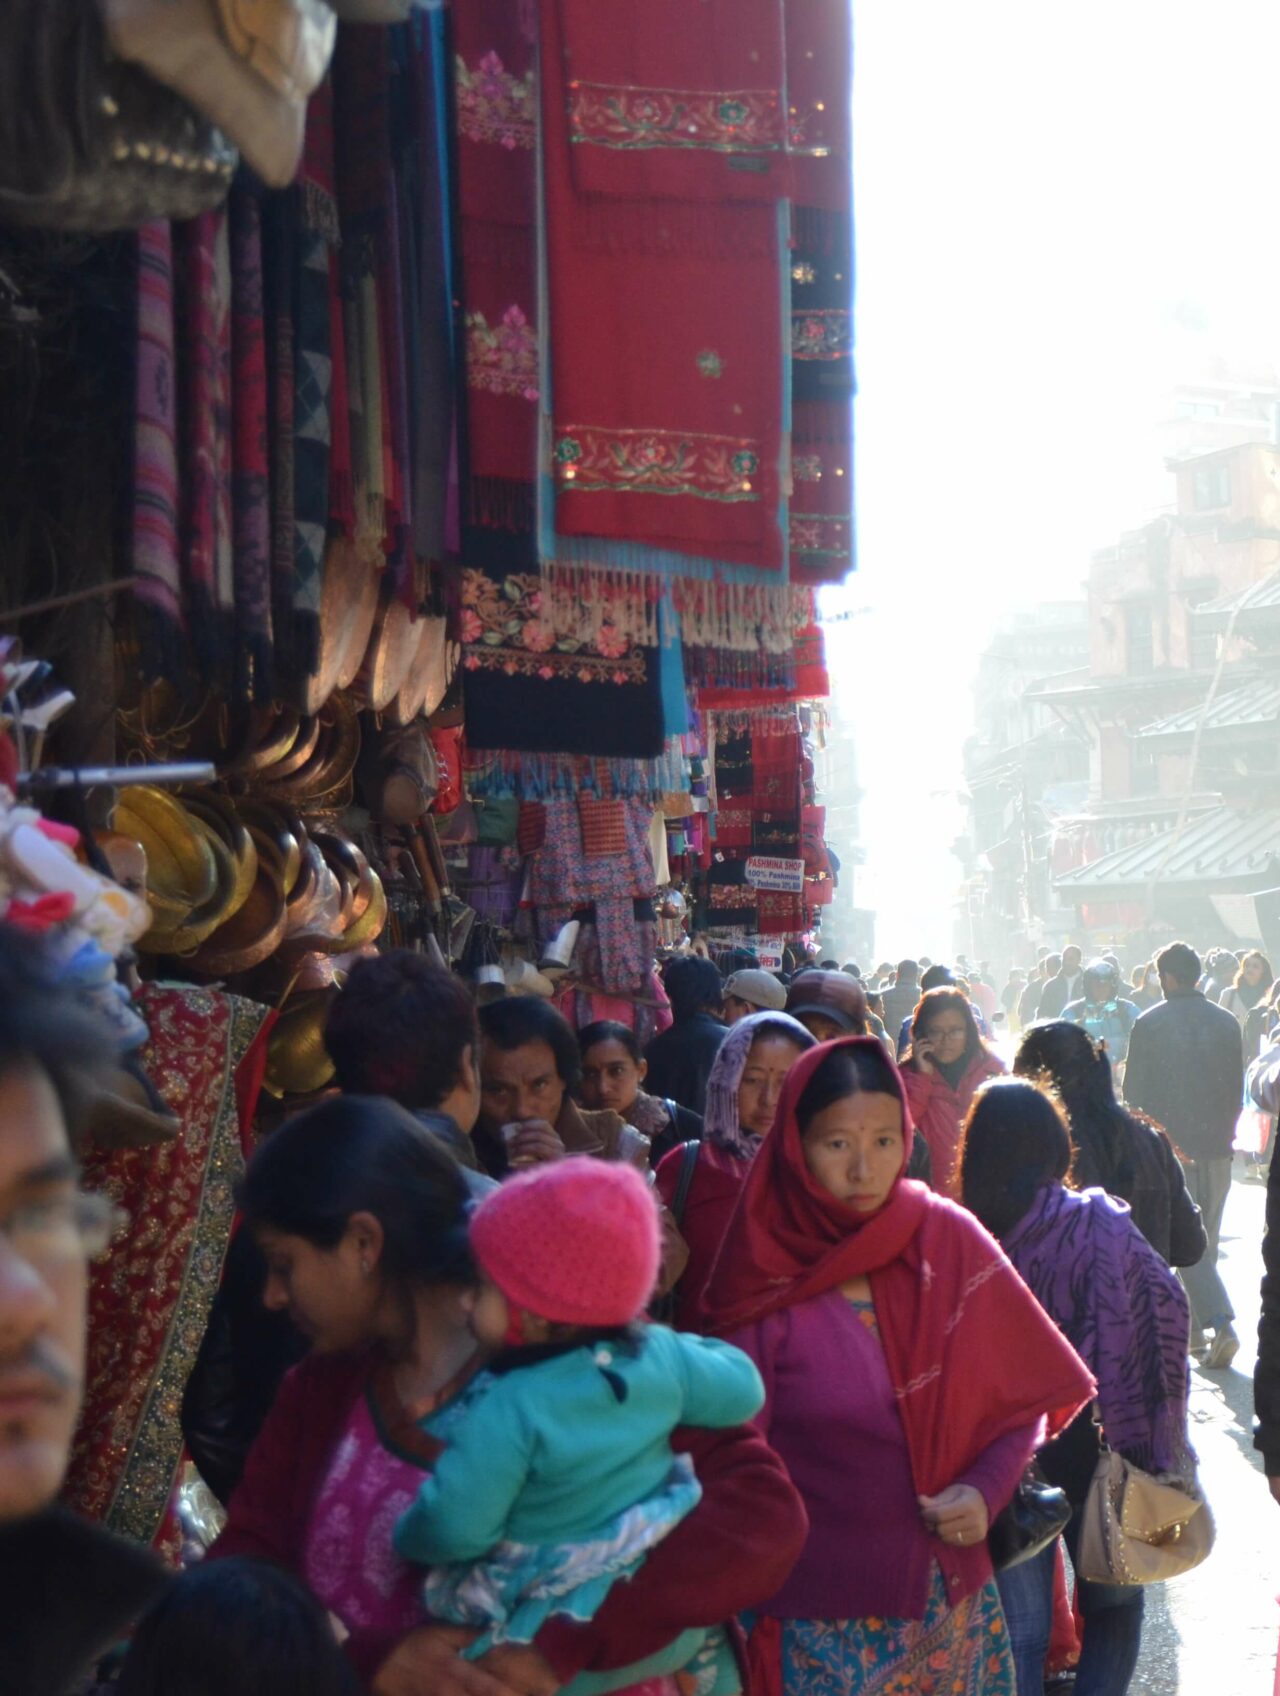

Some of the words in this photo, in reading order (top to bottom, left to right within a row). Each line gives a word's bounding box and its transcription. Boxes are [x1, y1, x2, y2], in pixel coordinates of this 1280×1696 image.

[748, 856, 783, 870] PASHMINA
[784, 861, 802, 871] SHOP
[748, 869, 768, 878] 100%
[768, 871, 801, 880] Pashmina
